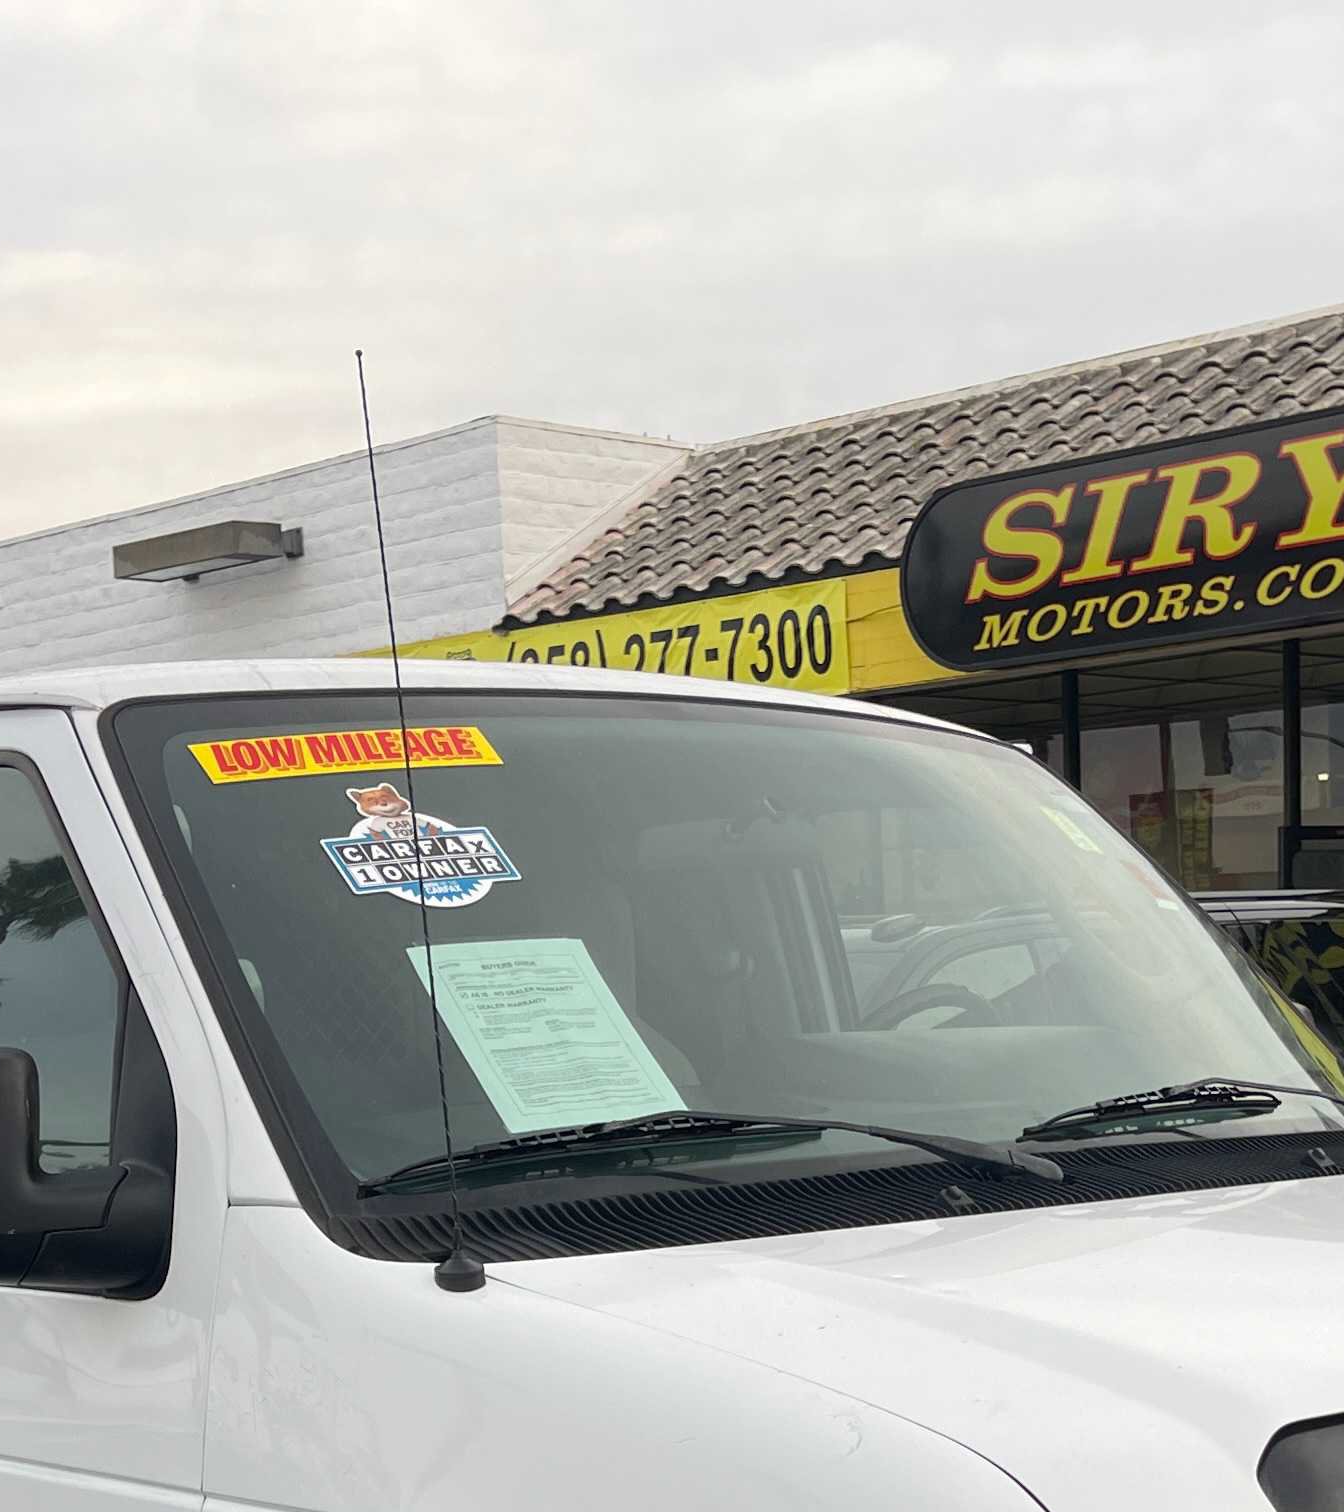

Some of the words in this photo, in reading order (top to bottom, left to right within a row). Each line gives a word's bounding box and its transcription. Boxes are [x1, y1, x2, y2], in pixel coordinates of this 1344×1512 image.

[210, 737, 305, 776] LOW
[305, 728, 481, 767] MILEAGE
[341, 836, 489, 863] CARFAX
[355, 867, 377, 884] 1
[381, 856, 505, 882] OWNER
